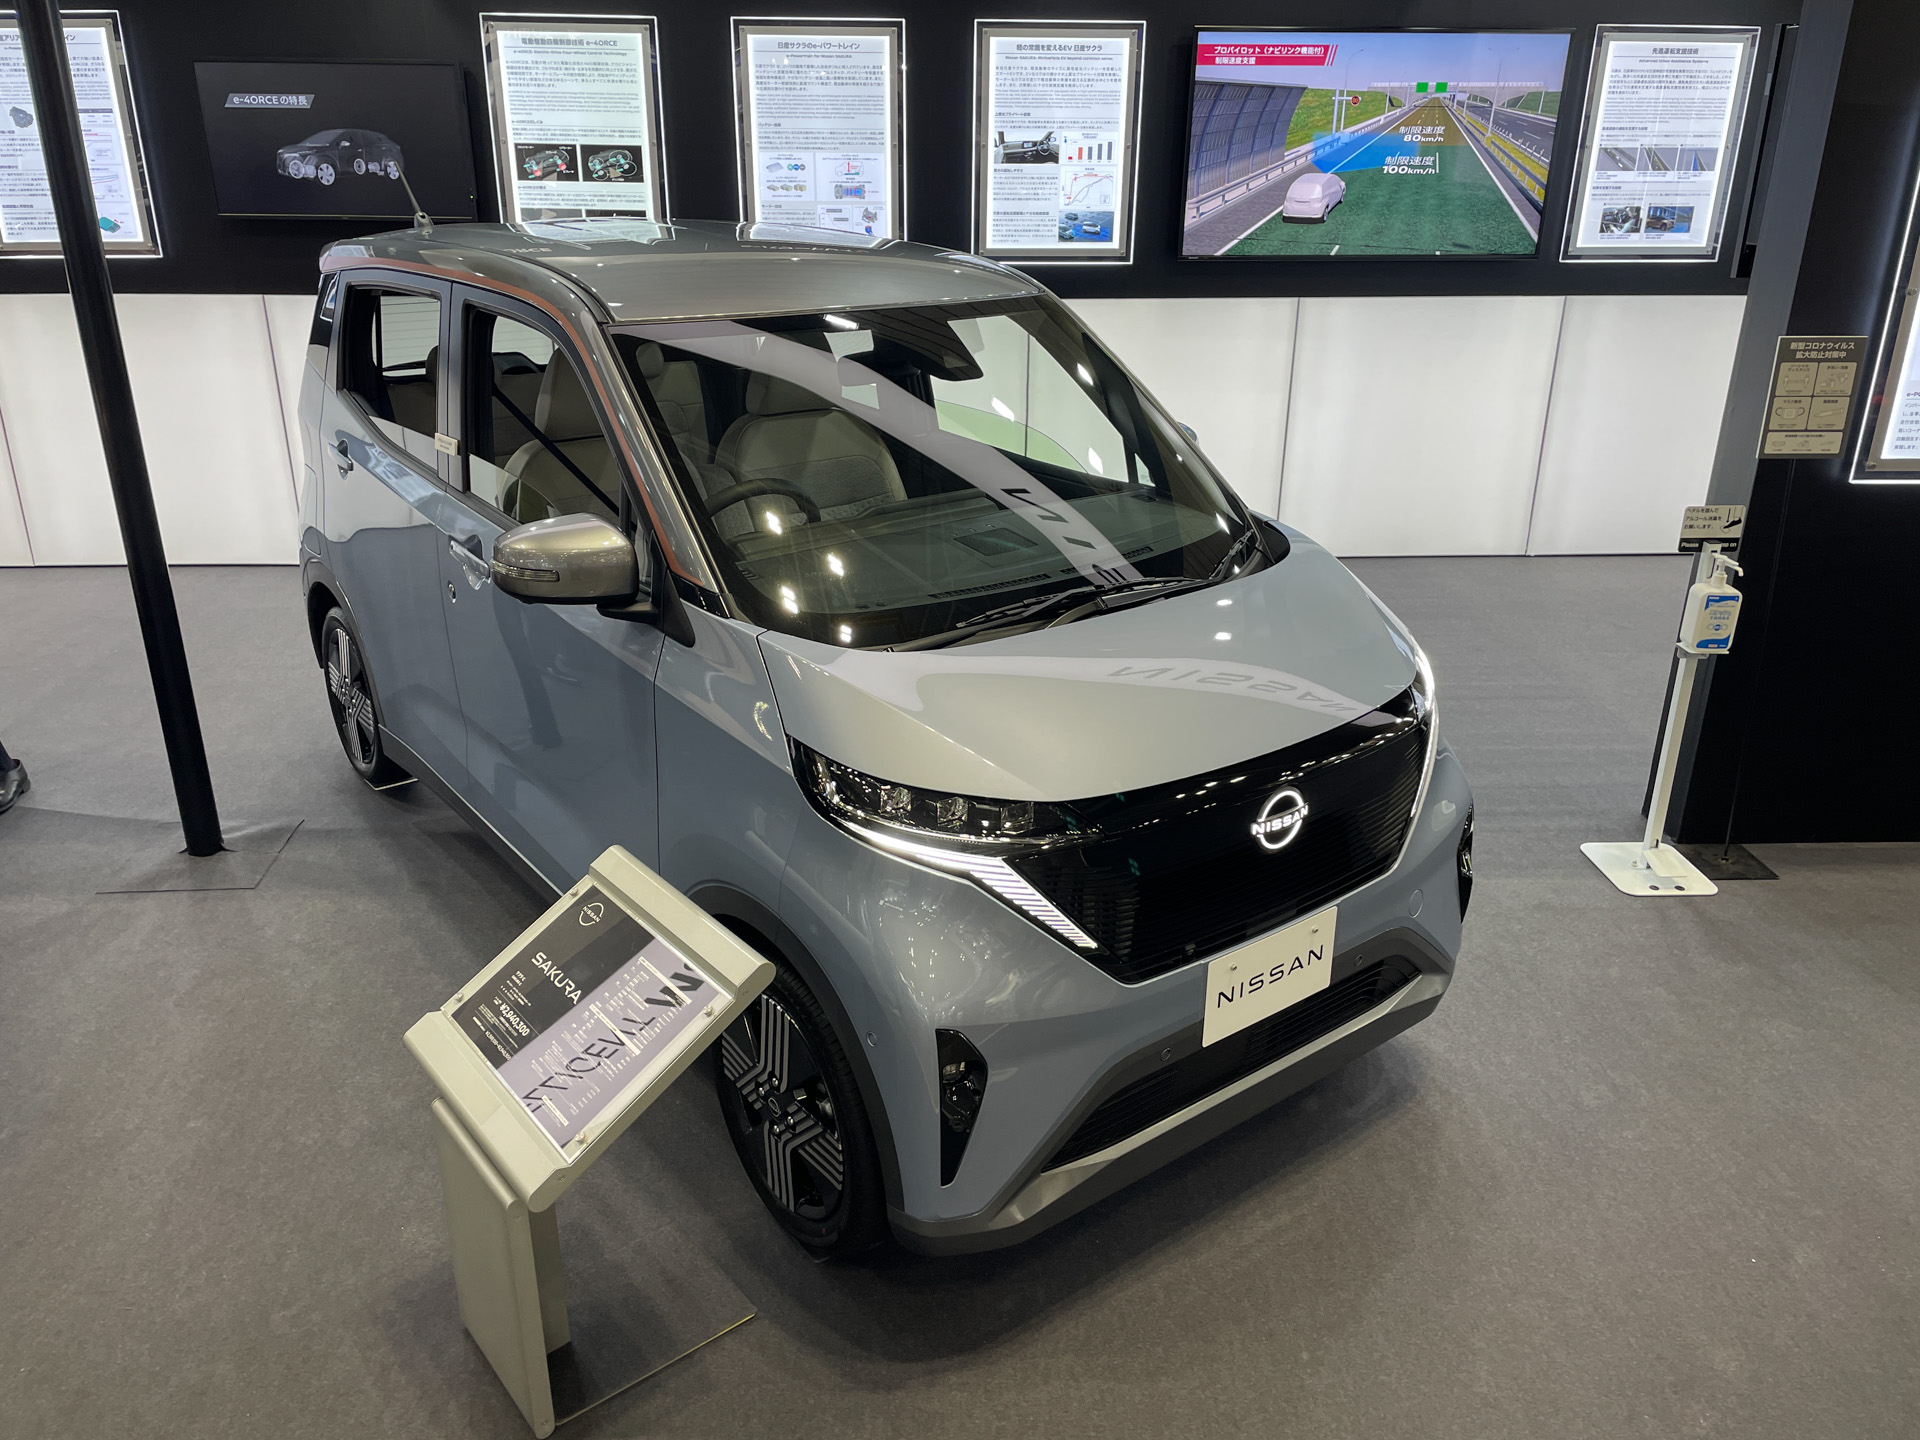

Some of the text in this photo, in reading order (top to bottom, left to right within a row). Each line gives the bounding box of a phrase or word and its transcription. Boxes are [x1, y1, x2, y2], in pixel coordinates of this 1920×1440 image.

[777, 42, 860, 50] 日産サクラのe-パワートレイン
[233, 96, 308, 105] e-4ORCEの特長
[1399, 126, 1445, 134] 制限速度
[1384, 156, 1435, 165] 制限速度
[1382, 166, 1435, 174] 100km/h
[1790, 342, 1855, 350] 新型コロナウイルス
[1796, 351, 1846, 359] 拡大防止対策中
[1251, 803, 1309, 836] NISSAN
[582, 904, 602, 923] NISSAN
[530, 951, 582, 1004] SAKURA
[1217, 944, 1324, 1008] NISSAN
[500, 1002, 530, 1036] ¥2,940,300
